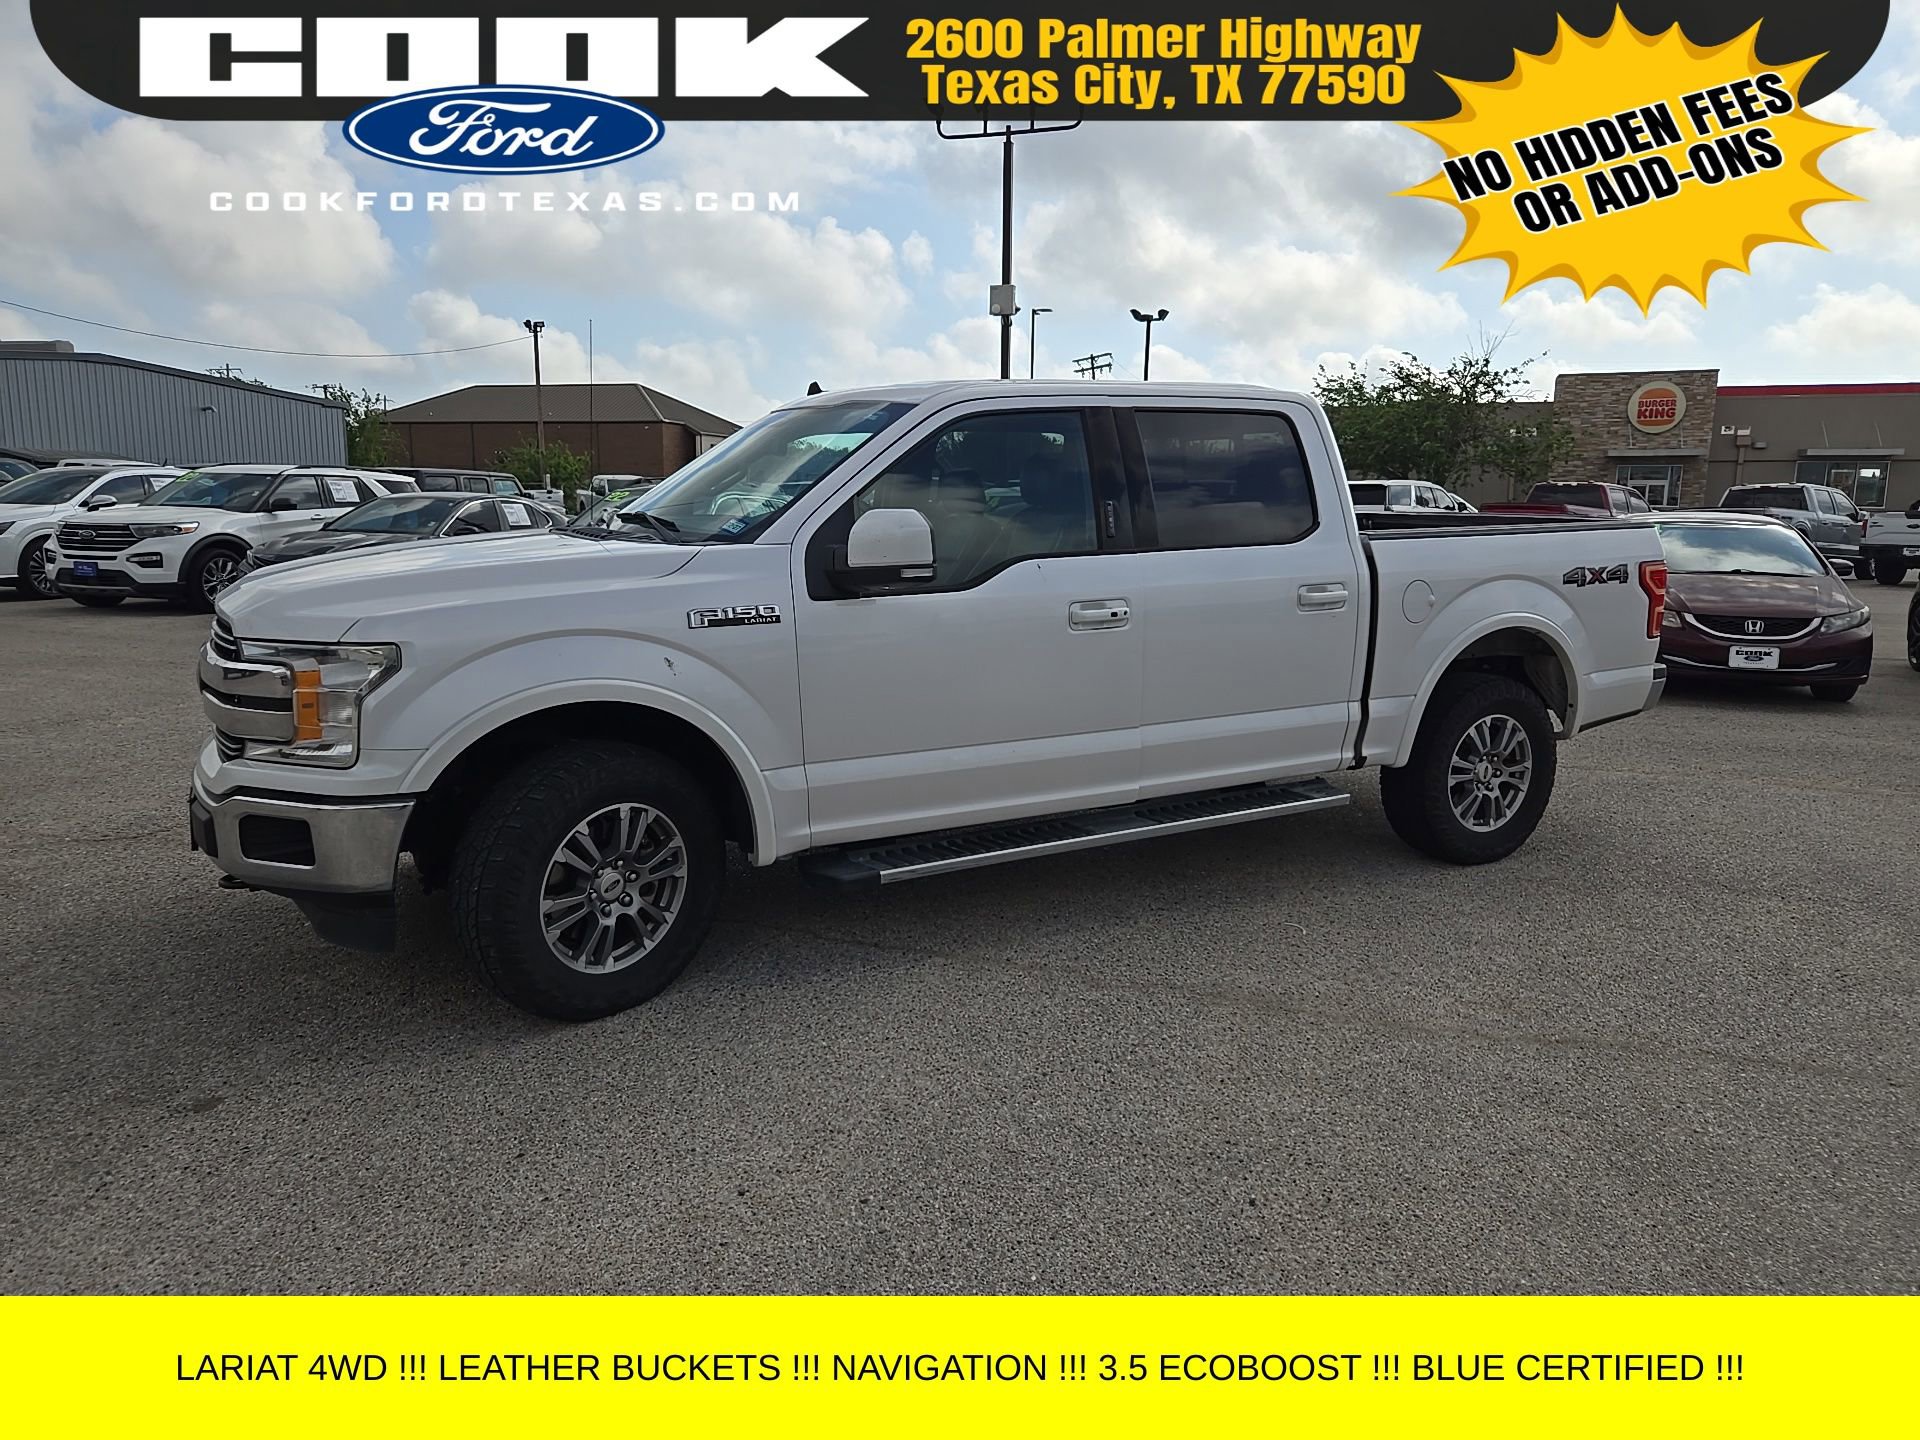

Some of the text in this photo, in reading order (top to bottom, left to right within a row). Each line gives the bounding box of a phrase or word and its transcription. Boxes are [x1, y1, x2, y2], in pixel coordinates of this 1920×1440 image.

[1638, 399, 1677, 408] BURGER
[1637, 408, 1676, 419] KING
[744, 616, 777, 624] LARIAT
